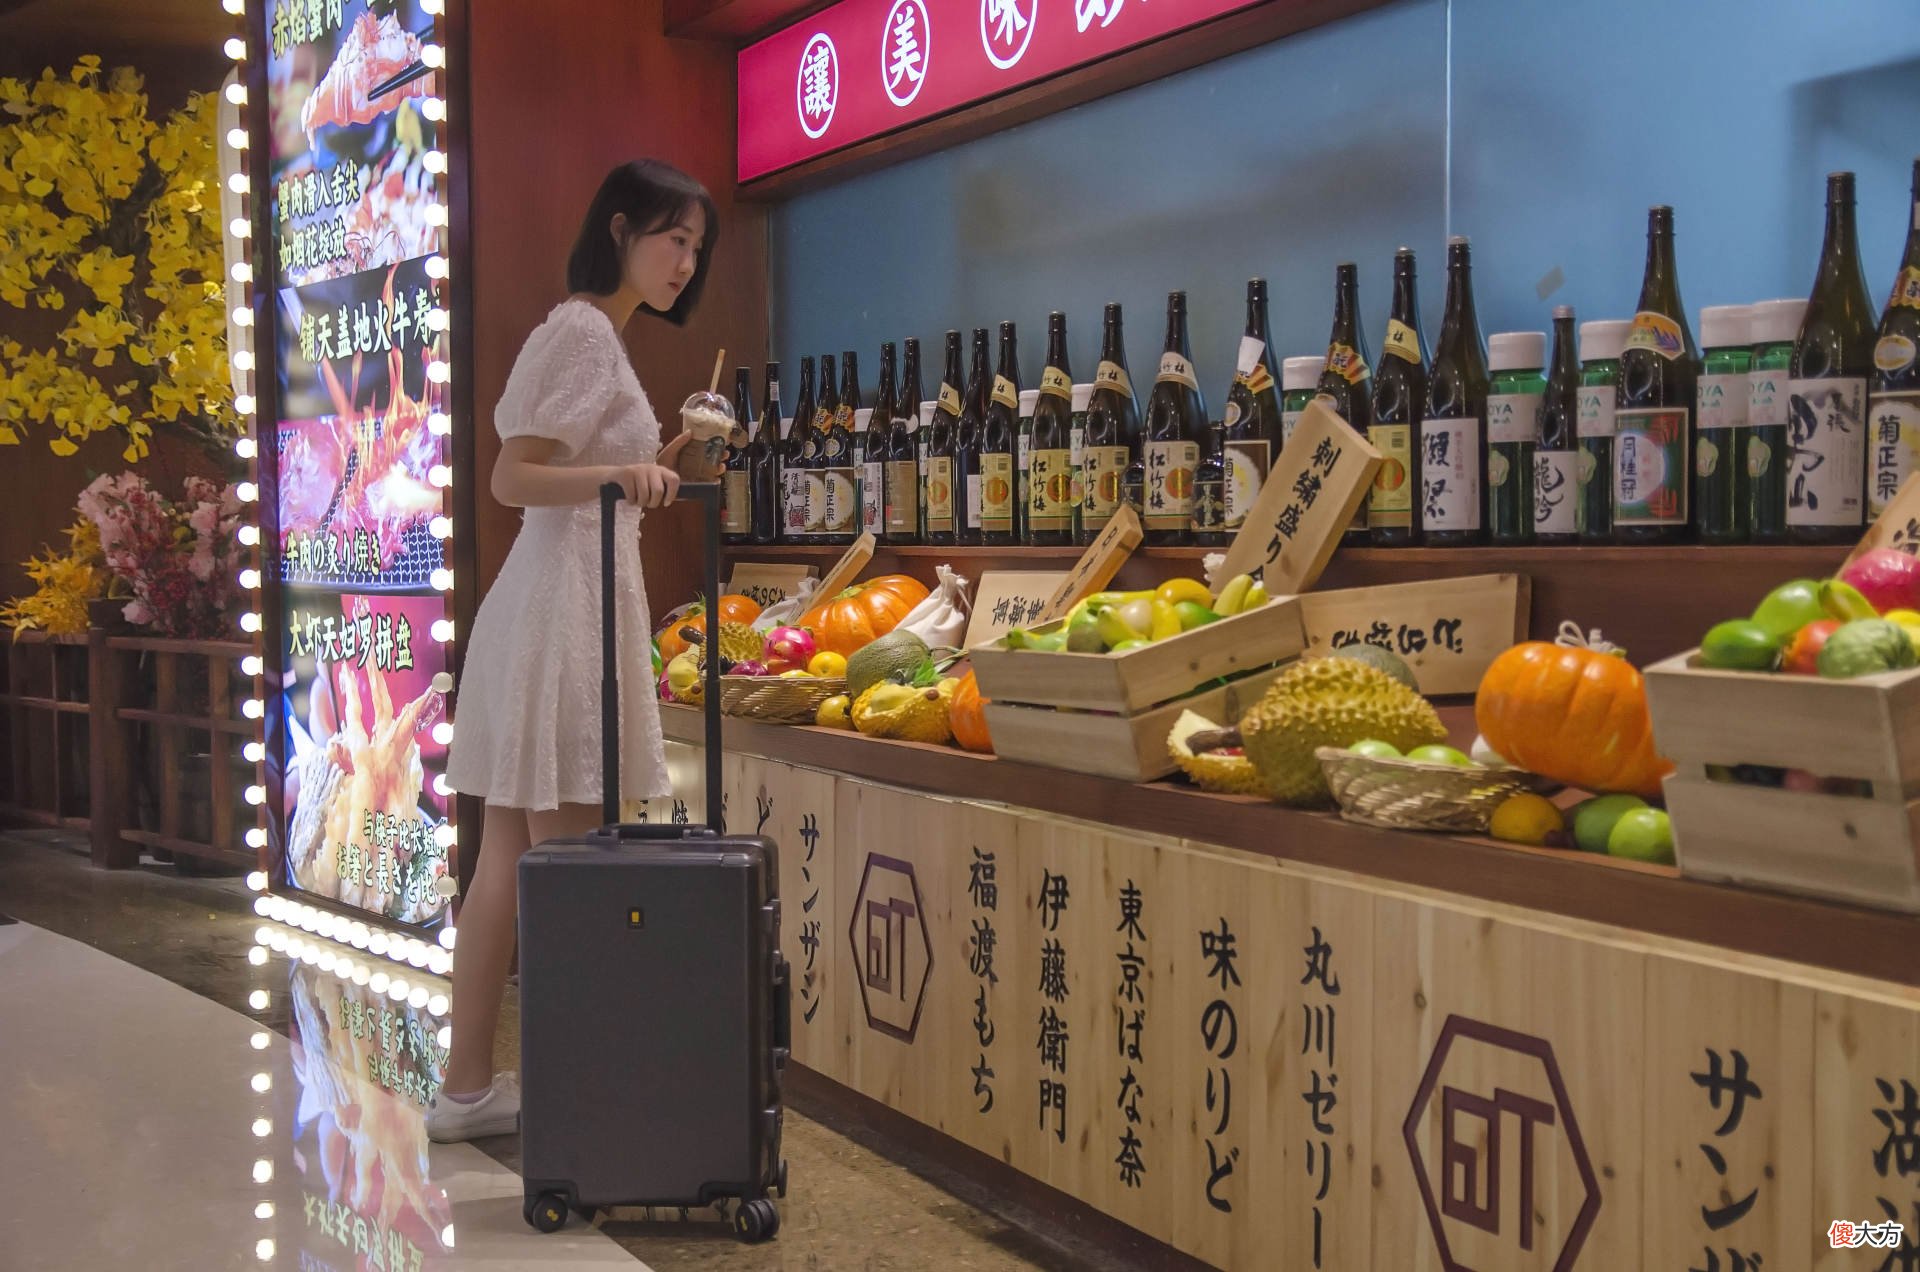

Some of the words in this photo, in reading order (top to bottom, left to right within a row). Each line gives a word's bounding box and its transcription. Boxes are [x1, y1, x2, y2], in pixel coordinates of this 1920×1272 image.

[277, 158, 360, 223] 蟹肉滑入舌尖
[278, 215, 347, 273] 如烟花绽放
[1031, 455, 1048, 512] 松竹梅
[1083, 453, 1097, 511] 松竹梅
[1148, 448, 1165, 511] 松竹梅
[1621, 436, 1638, 501] 月桂冠
[1877, 413, 1901, 502] 菊正宗
[286, 529, 382, 577] 牛肉の炙り焼き
[289, 609, 414, 672] 大虾天妇罗拼盘
[799, 813, 822, 1026] サンザン
[967, 845, 999, 1115] 福渡もち
[1036, 867, 1071, 1145] 伊藤衛門
[1114, 878, 1147, 1190] 東京ばな奈
[1199, 916, 1243, 1214] 味のりど
[1299, 925, 1342, 1271] 丸川ゼリー
